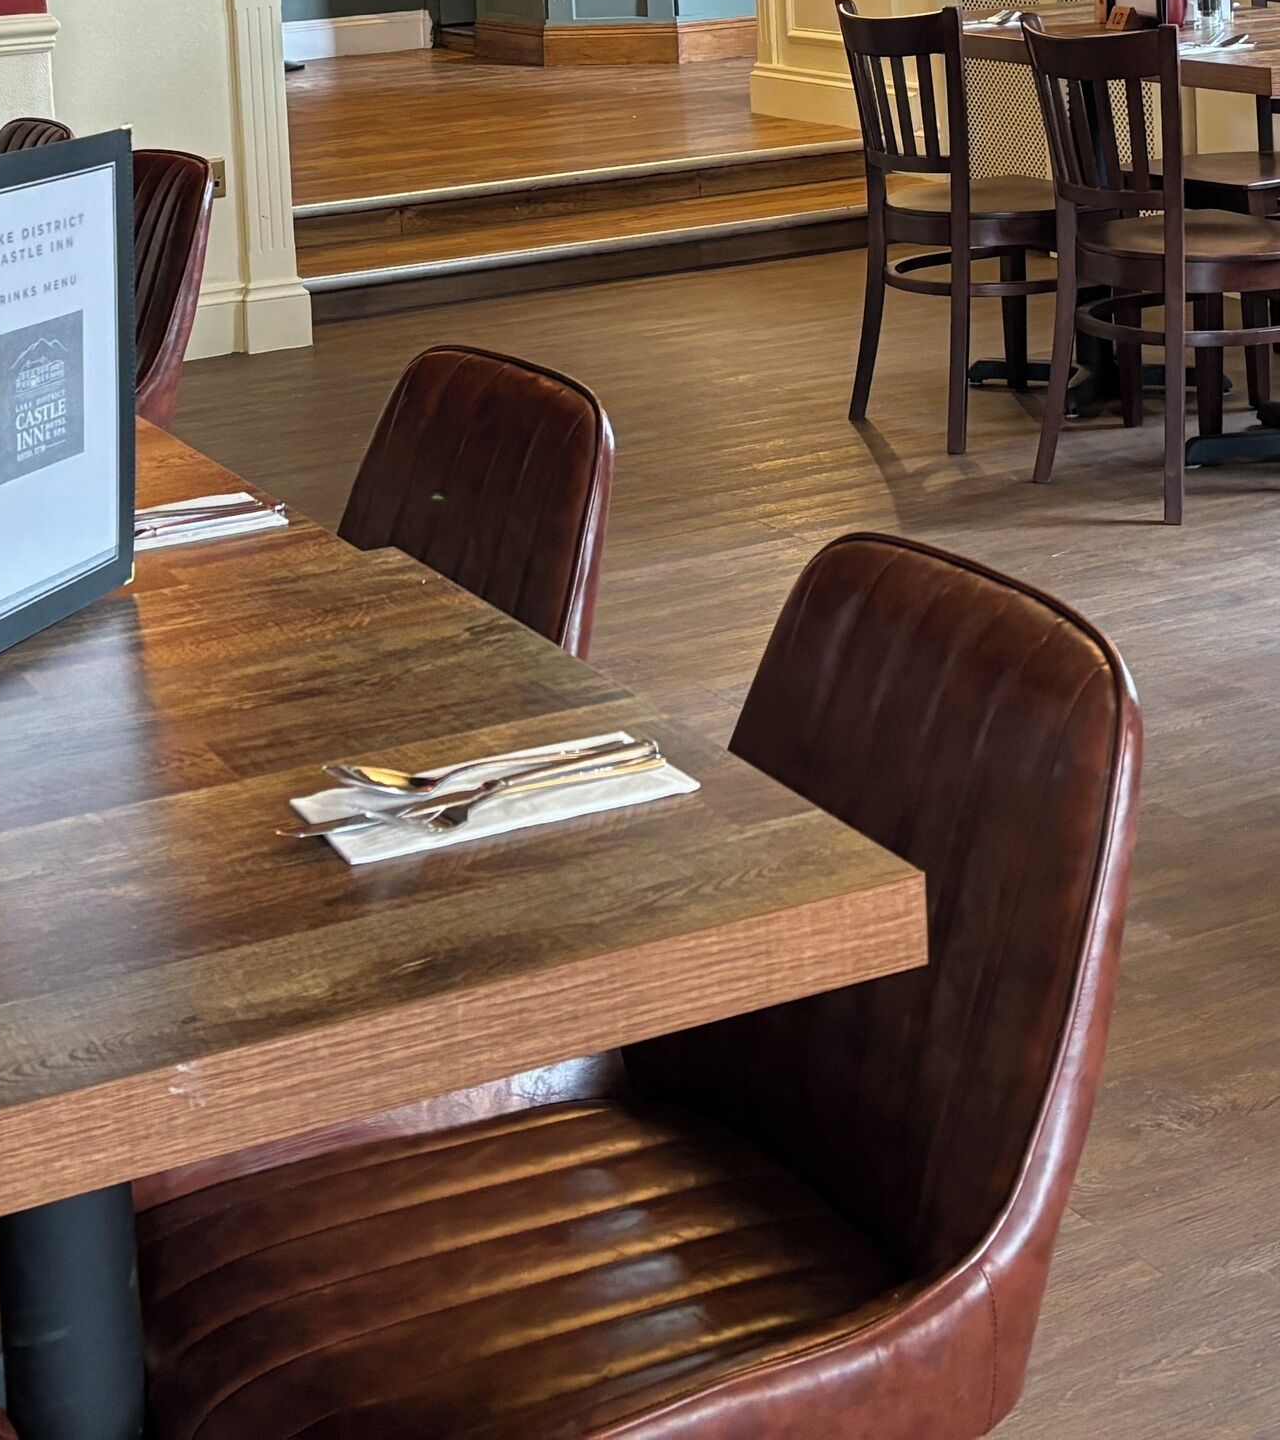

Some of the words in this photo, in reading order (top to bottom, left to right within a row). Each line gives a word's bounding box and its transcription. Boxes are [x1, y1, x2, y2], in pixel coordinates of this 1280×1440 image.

[21, 213, 84, 240] DISTRICT
[50, 236, 74, 253] INN
[43, 274, 77, 293] MENU
[15, 398, 66, 430] CASTLE
[16, 425, 45, 452] INN
